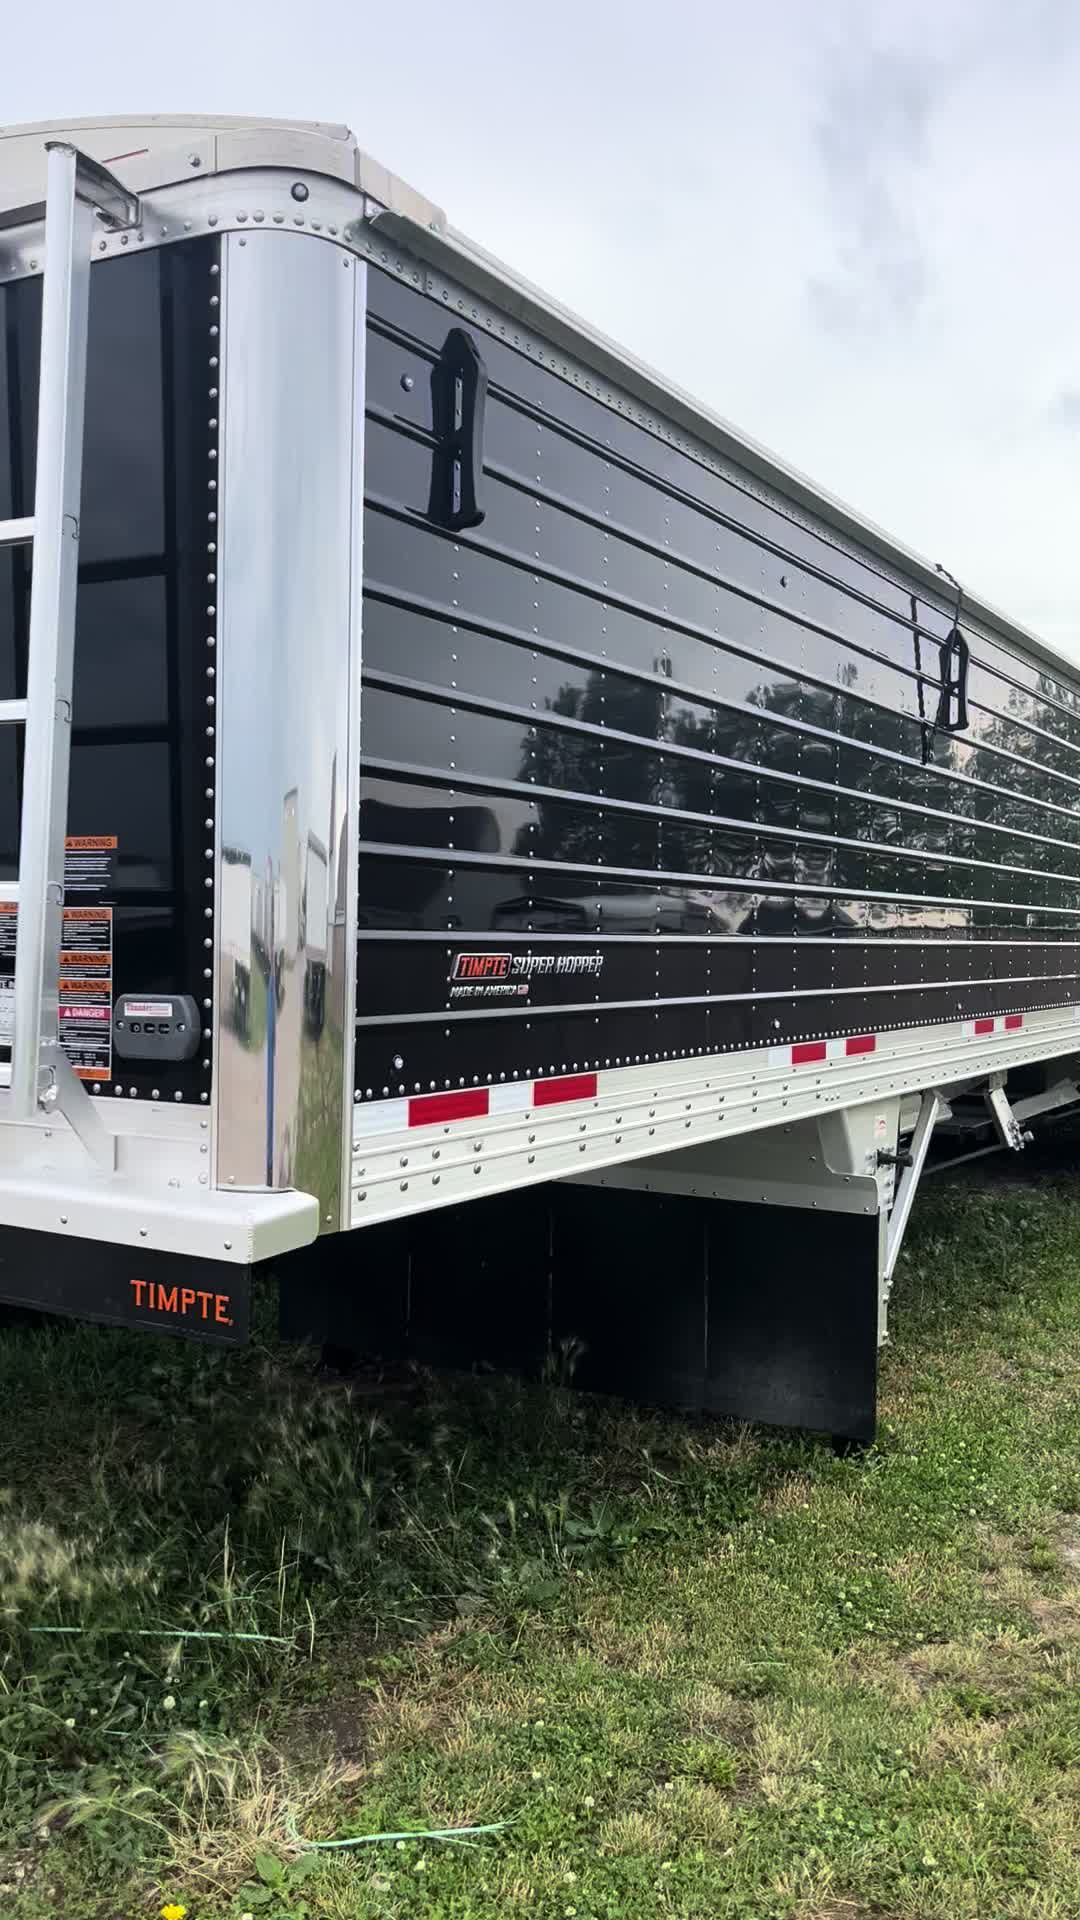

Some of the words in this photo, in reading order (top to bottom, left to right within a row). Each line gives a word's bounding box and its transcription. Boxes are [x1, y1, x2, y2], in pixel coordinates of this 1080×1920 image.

[73, 838, 113, 847] WARNING
[71, 910, 107, 919] WARNING
[71, 954, 108, 963] WARNING
[460, 957, 510, 976] TIMPTE
[511, 956, 554, 974] SUPER
[556, 956, 604, 974] HOPPER
[71, 981, 108, 991] WARNING
[72, 1008, 105, 1018] DANGER
